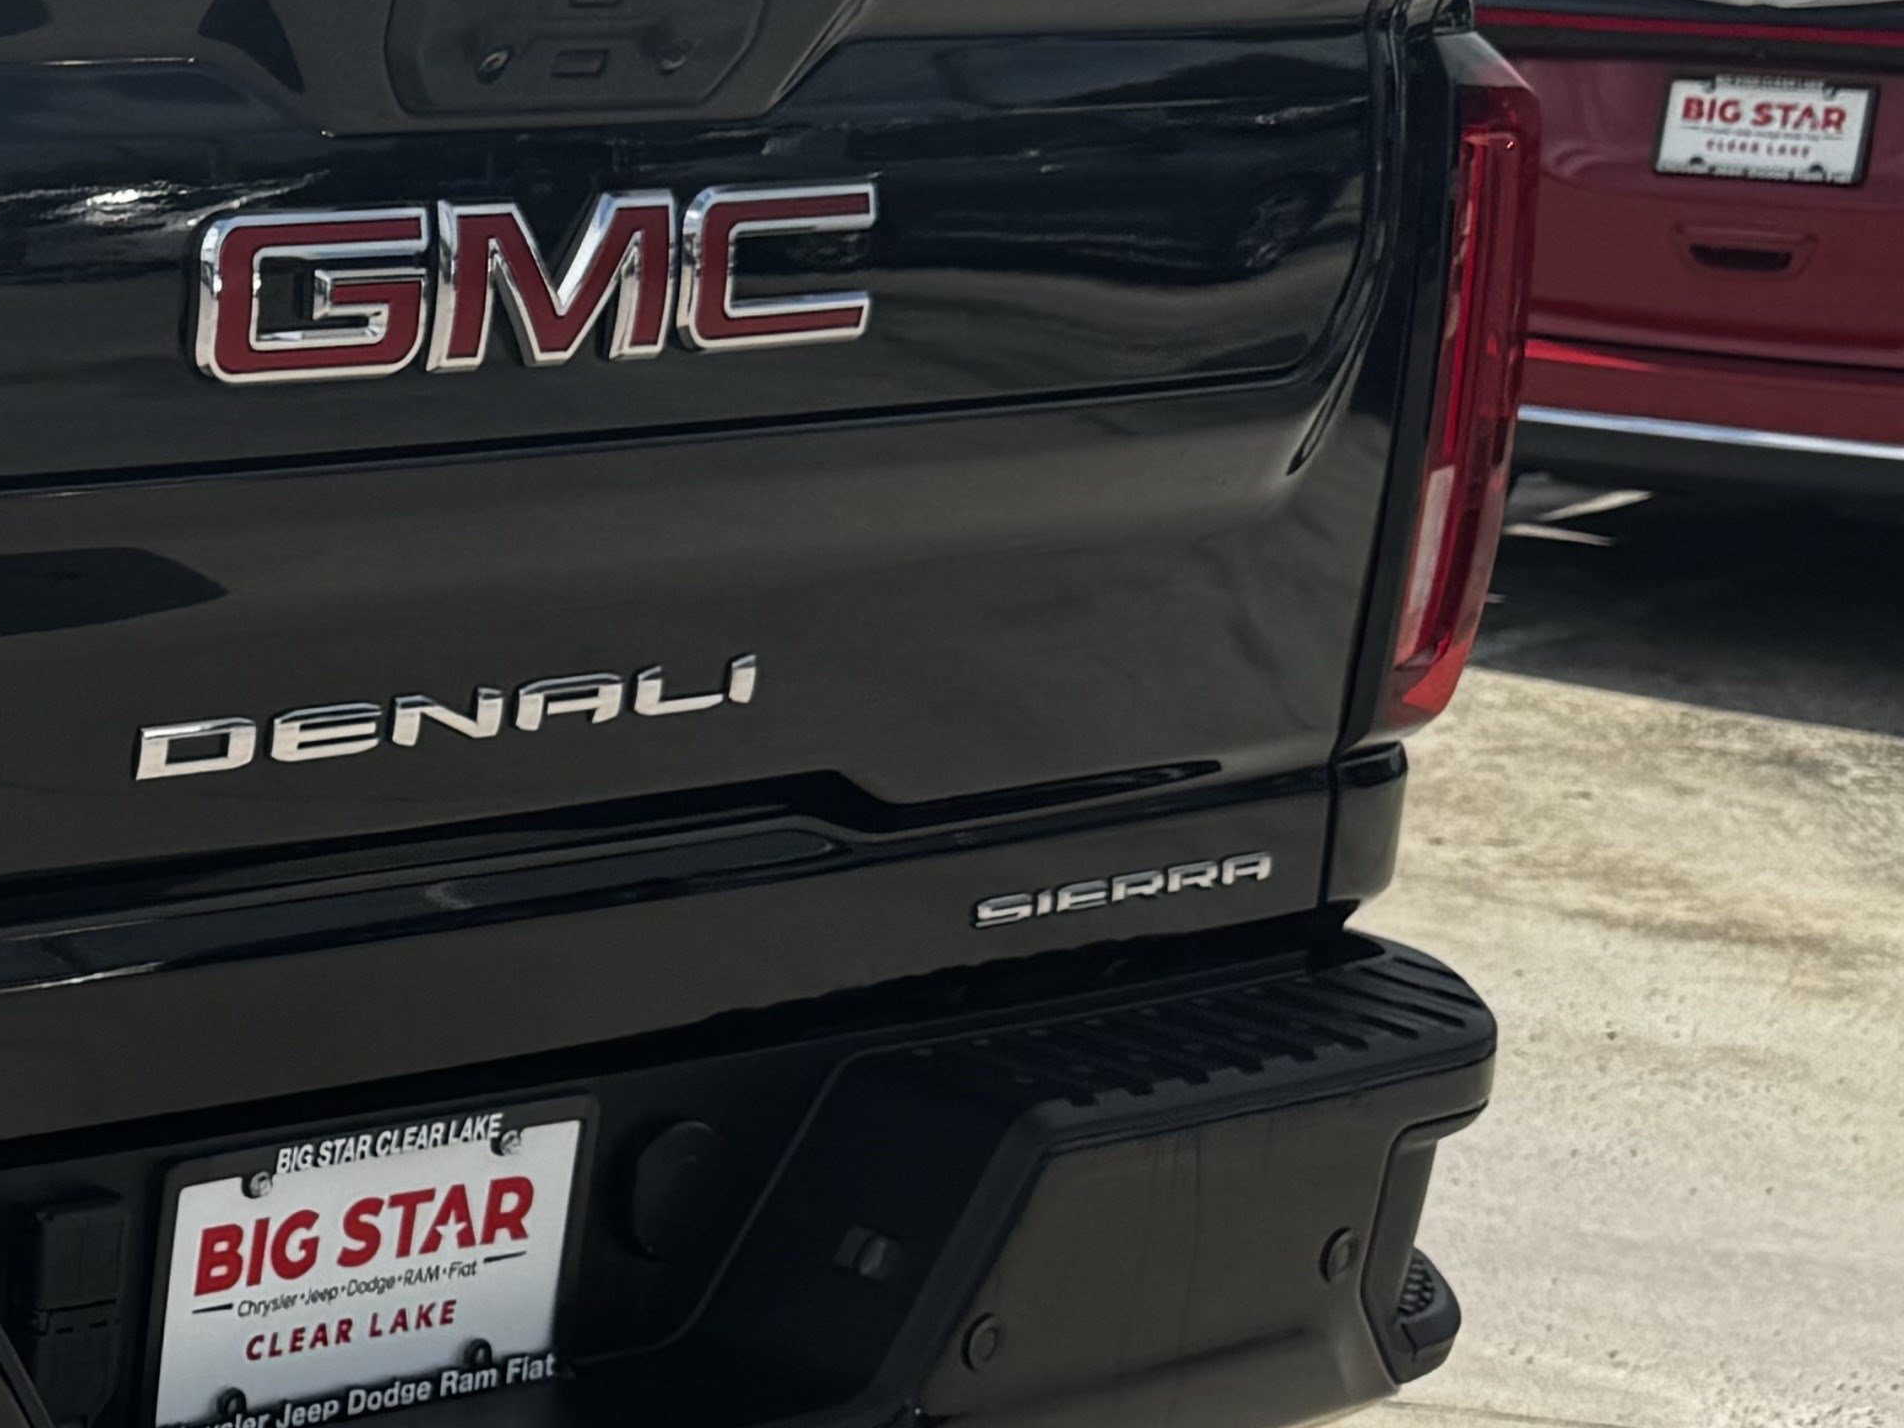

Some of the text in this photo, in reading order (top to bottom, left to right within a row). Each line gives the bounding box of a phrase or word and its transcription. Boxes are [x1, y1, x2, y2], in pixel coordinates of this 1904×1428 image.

[1682, 97, 1847, 132] BIG STAR
[195, 182, 877, 383] GMC
[136, 654, 757, 780] DENALI
[975, 851, 1271, 928] SIERRA
[276, 1113, 503, 1173] BIG STAR CLEAR LAKE
[194, 1176, 534, 1297] BIG STAR
[237, 1291, 298, 1317] Chrysler
[347, 1275, 395, 1297] Dodge
[403, 1265, 439, 1286] RAM
[448, 1259, 478, 1279] Fiat
[246, 1299, 457, 1361] CLEAR LAKE
[347, 1380, 432, 1415] Dodge
[440, 1368, 498, 1397] Ram
[506, 1352, 557, 1384] Fiat
